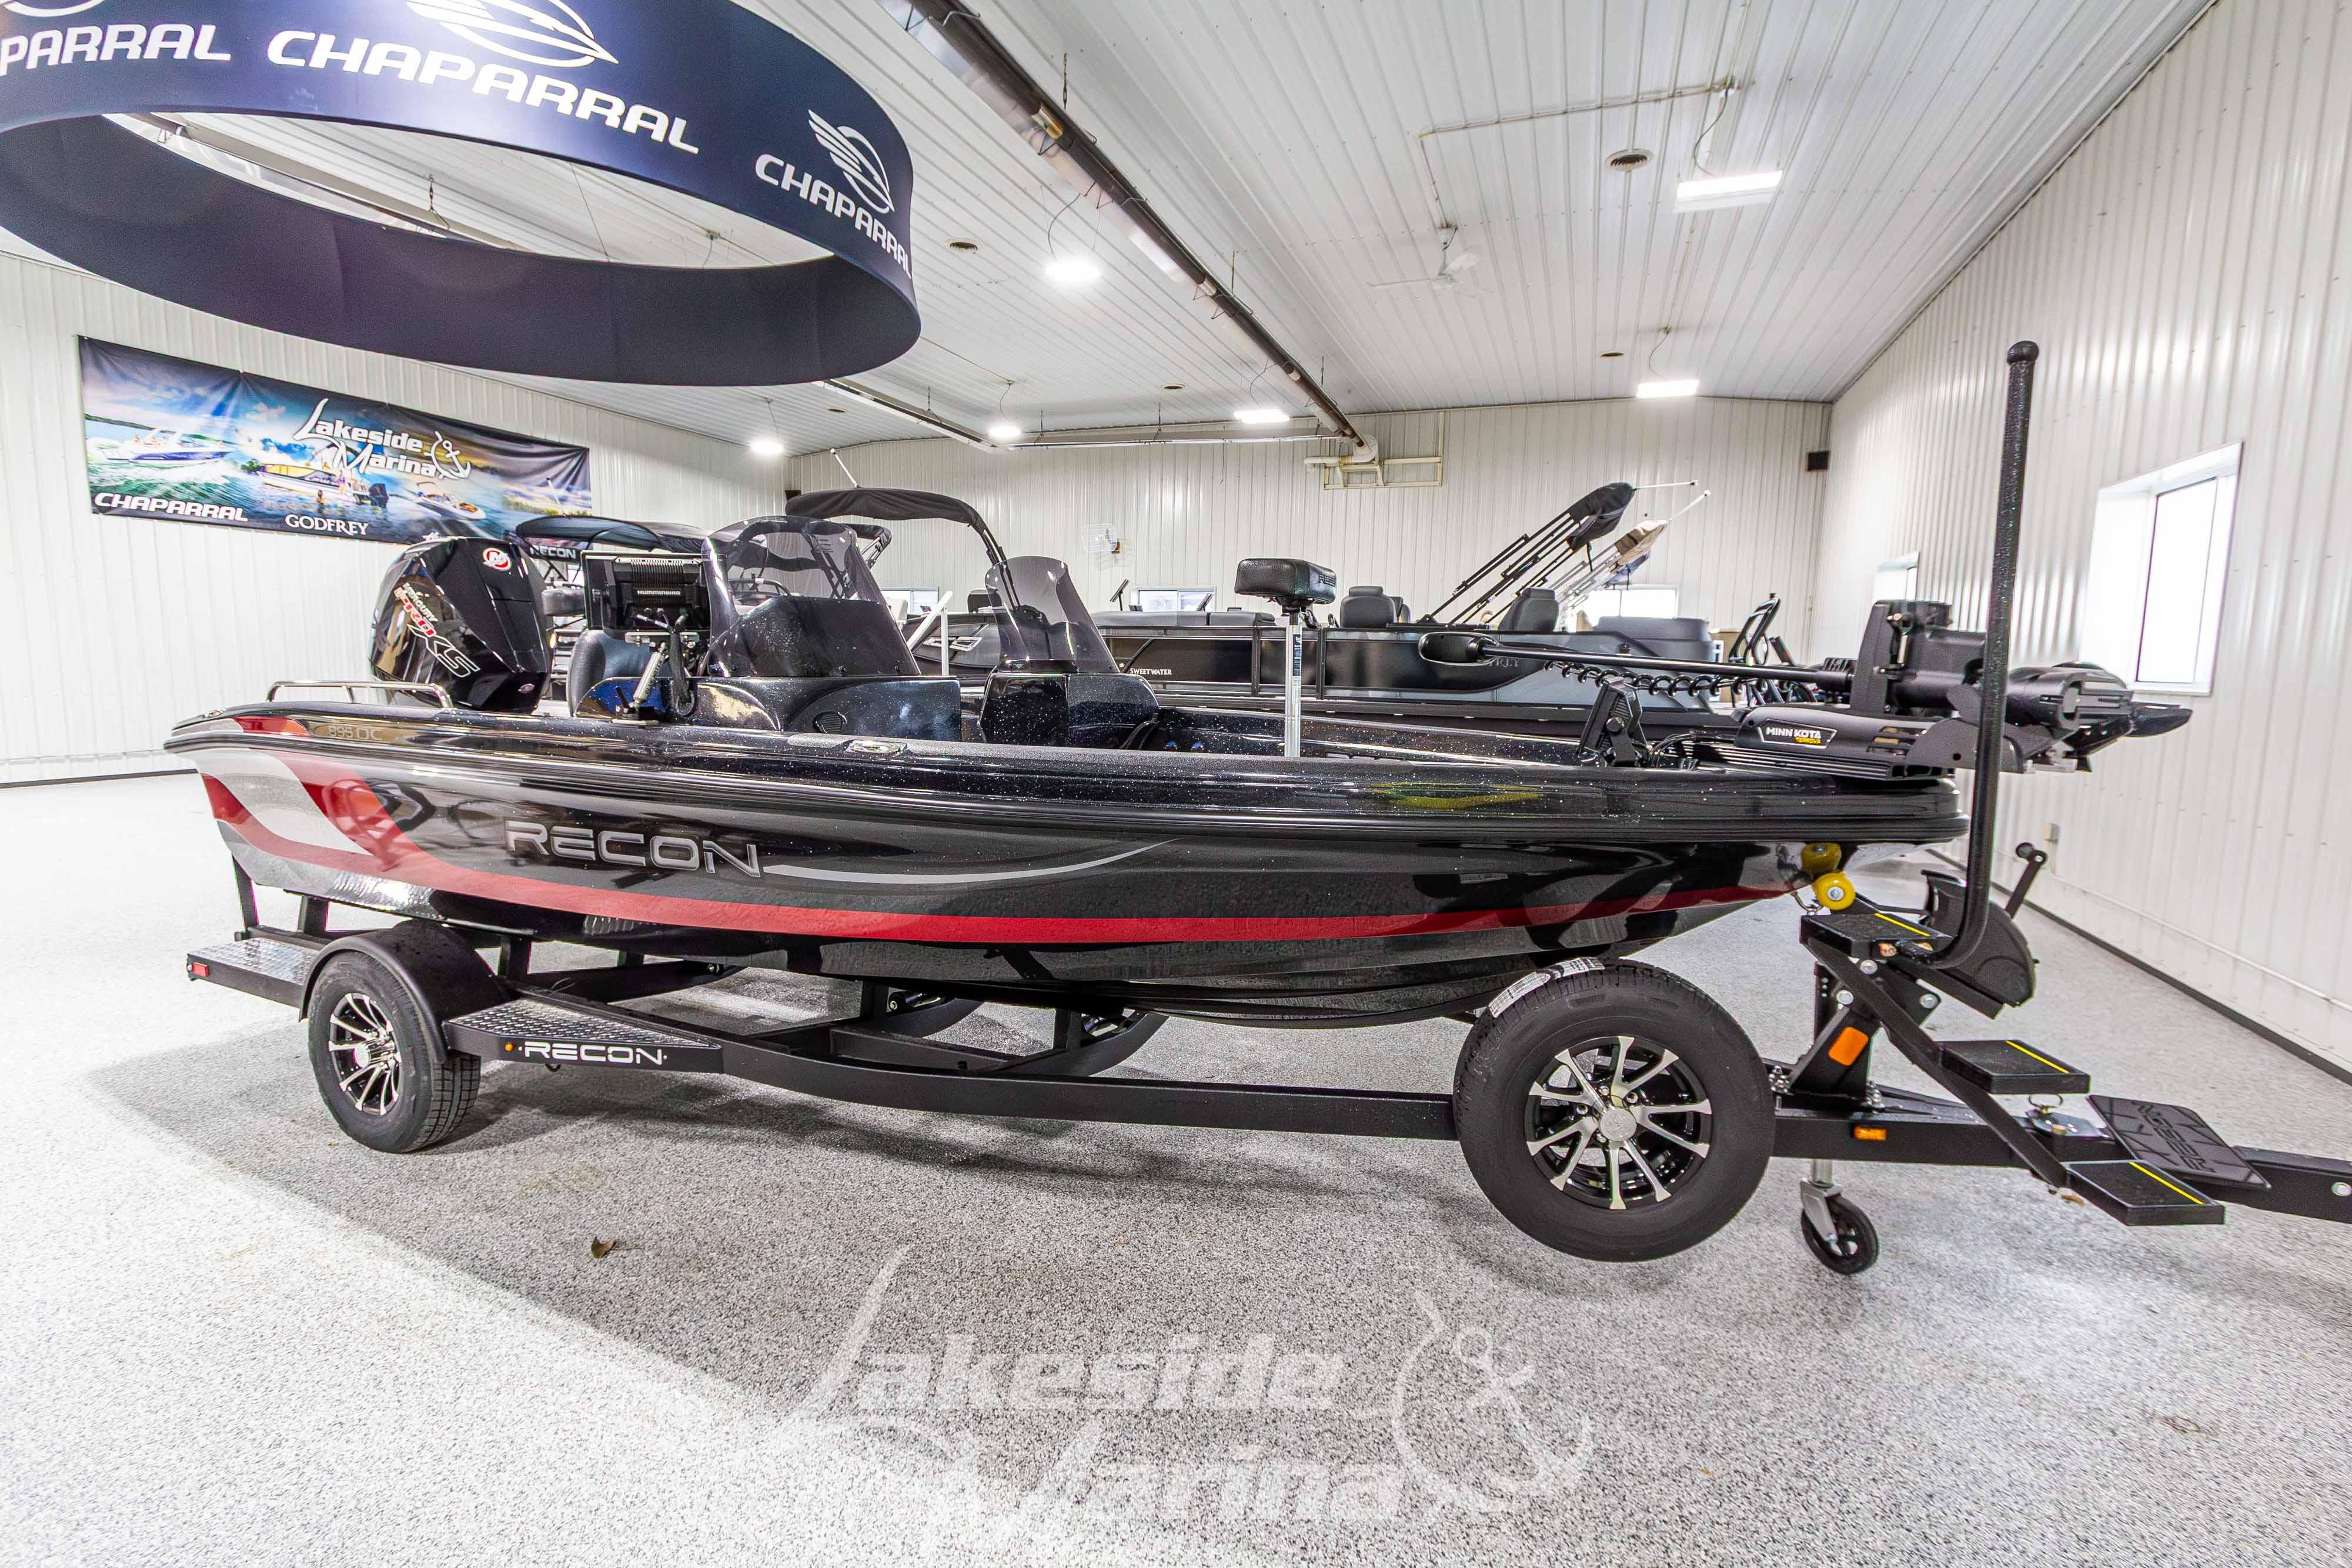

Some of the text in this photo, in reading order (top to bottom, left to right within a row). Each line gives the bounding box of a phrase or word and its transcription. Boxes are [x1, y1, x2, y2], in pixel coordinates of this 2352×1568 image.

[267, 30, 699, 154] CHAPARRAL
[755, 153, 911, 279] CHAPARRAL
[293, 397, 423, 453] Lakeside
[332, 441, 436, 478] Marina
[94, 492, 248, 522] CHAPARRAL
[285, 514, 369, 536] GODFREY
[406, 623, 481, 678] XS
[1765, 727, 1822, 739] MINN KOTA
[505, 820, 761, 878] RECON
[524, 1041, 663, 1065] RECON
